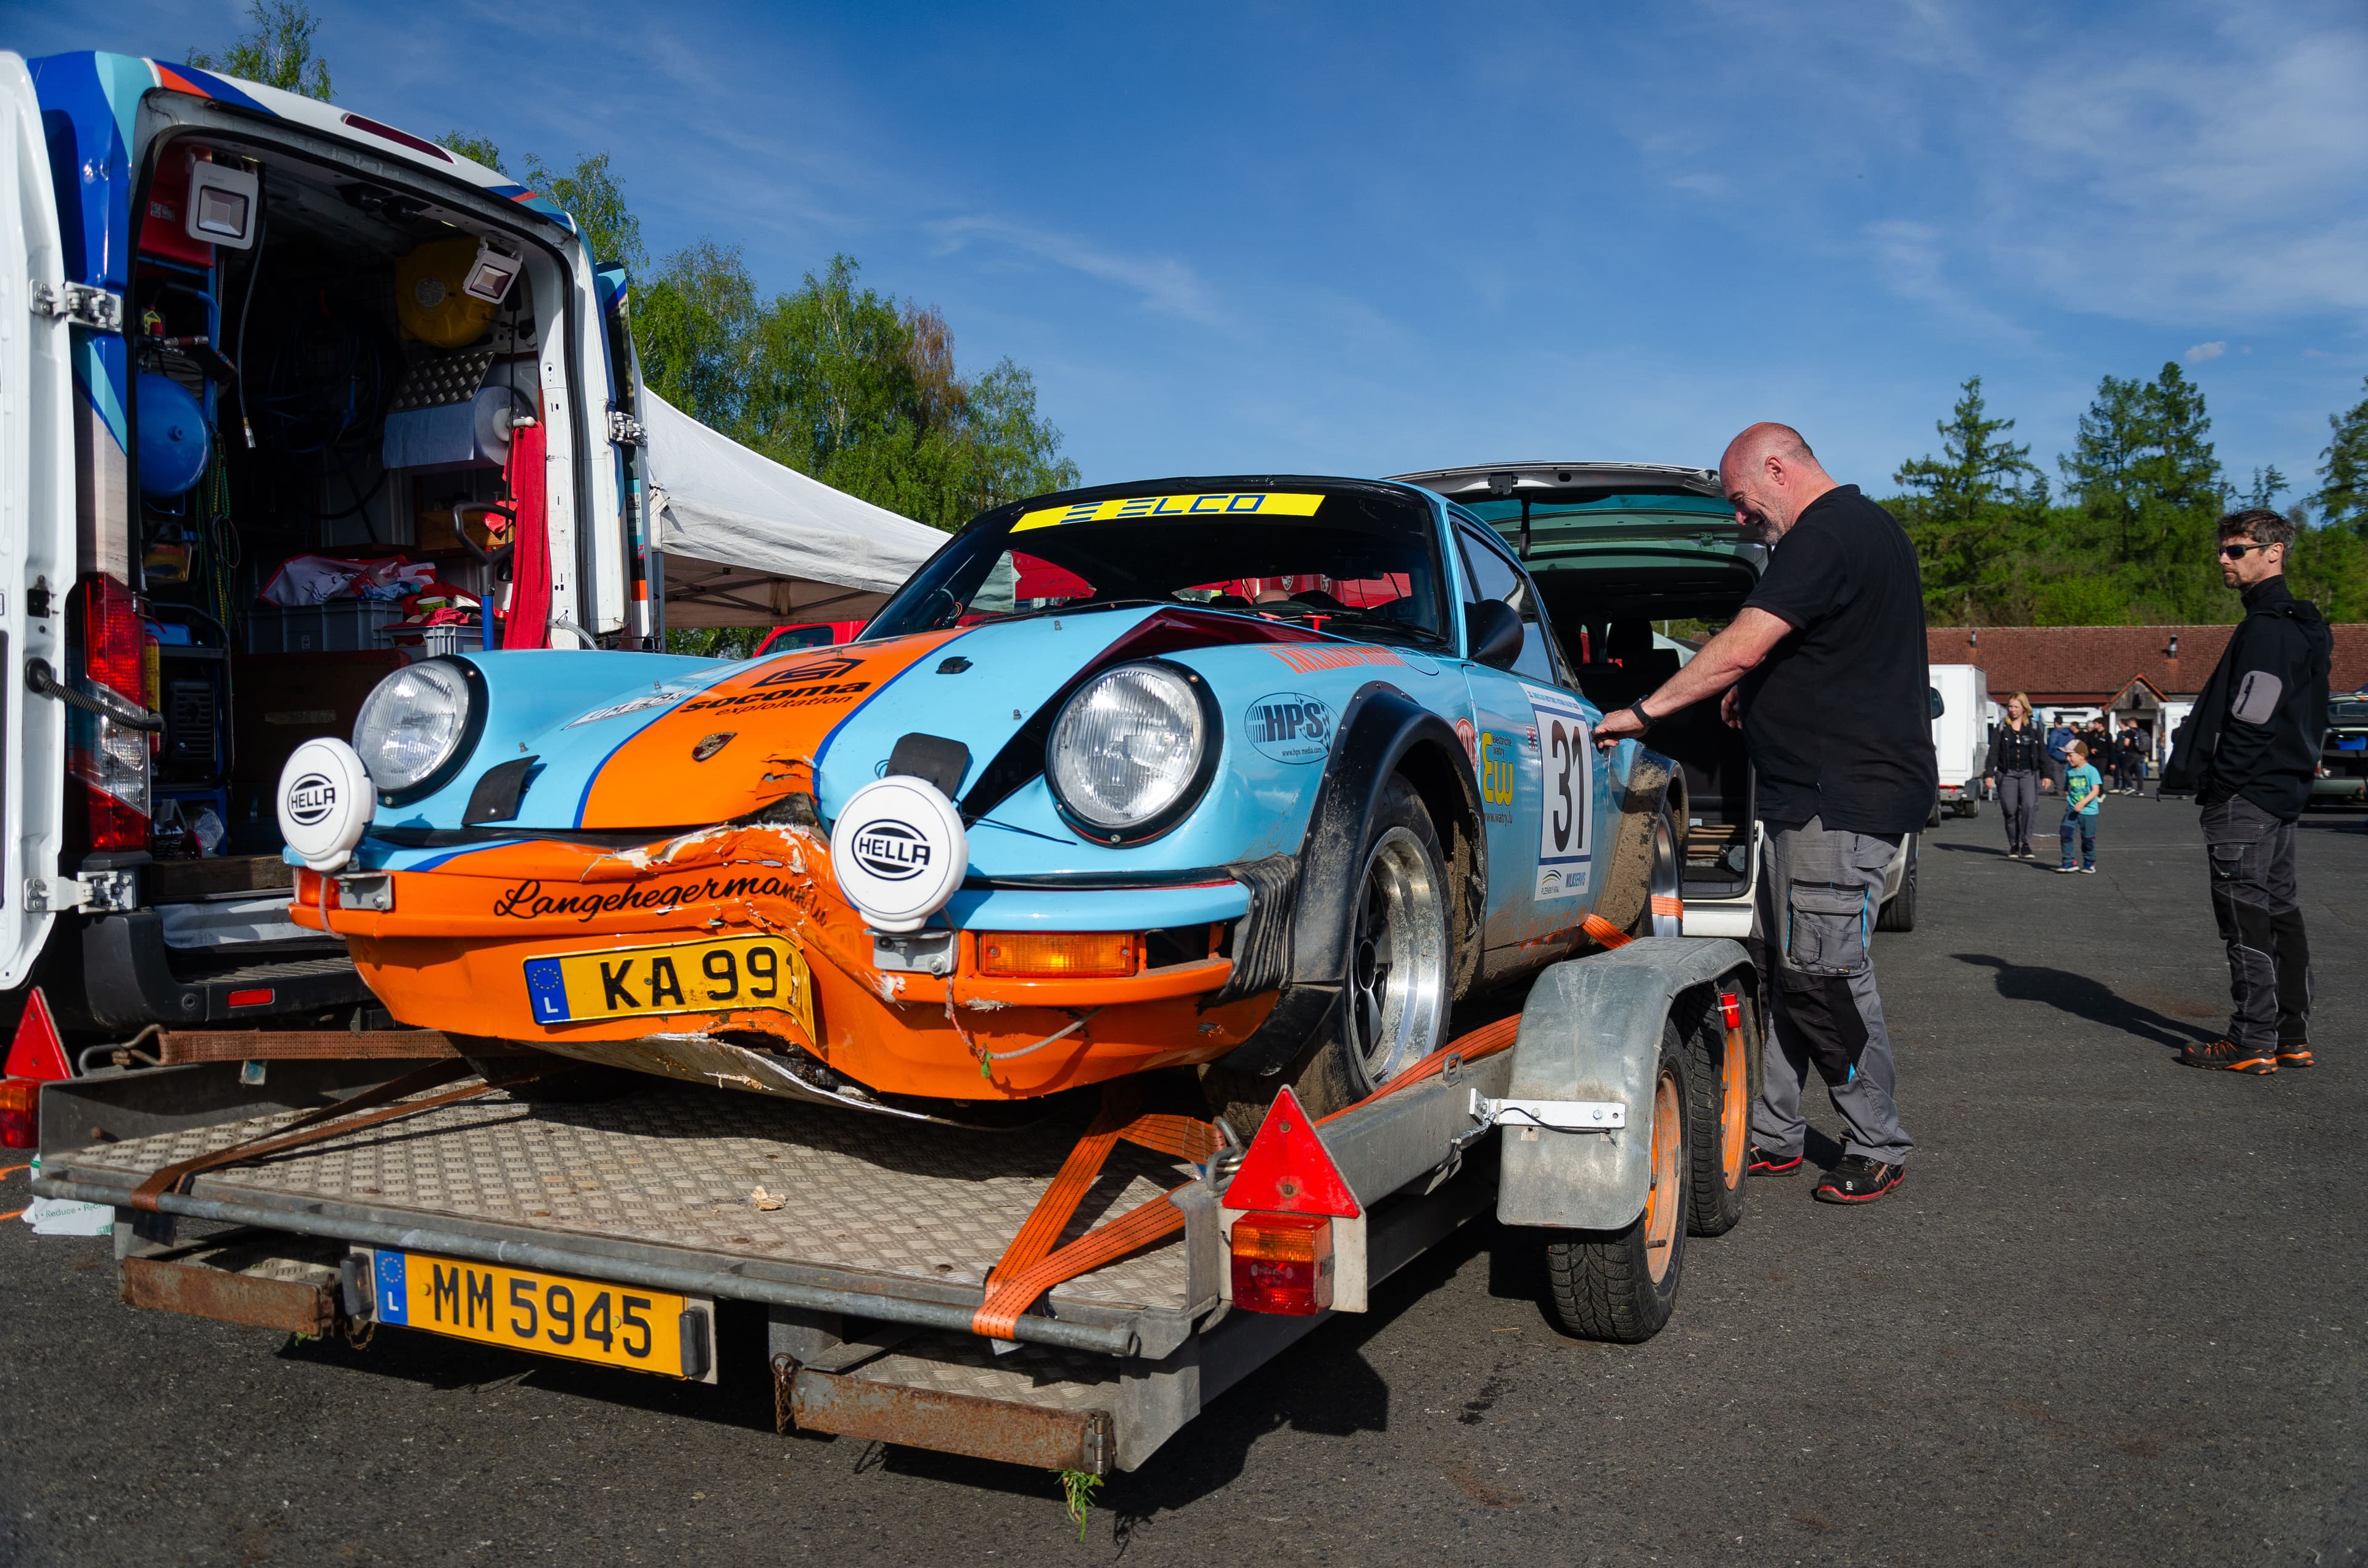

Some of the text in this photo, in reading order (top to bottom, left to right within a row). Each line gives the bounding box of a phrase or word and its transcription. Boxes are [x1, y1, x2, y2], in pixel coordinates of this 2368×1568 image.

[680, 681, 872, 713] socoma
[715, 696, 853, 716] exploitation
[1262, 703, 1324, 742] HPS
[1492, 746, 1505, 759] watry
[291, 787, 335, 810] HELLA
[1552, 720, 1584, 852] 31
[859, 837, 931, 866] HELLA
[599, 956, 686, 1011] KA
[543, 996, 559, 1014] L
[46, 1207, 76, 1218] Reduce
[387, 1291, 400, 1312] L
[433, 1263, 652, 1358] MM 5945
